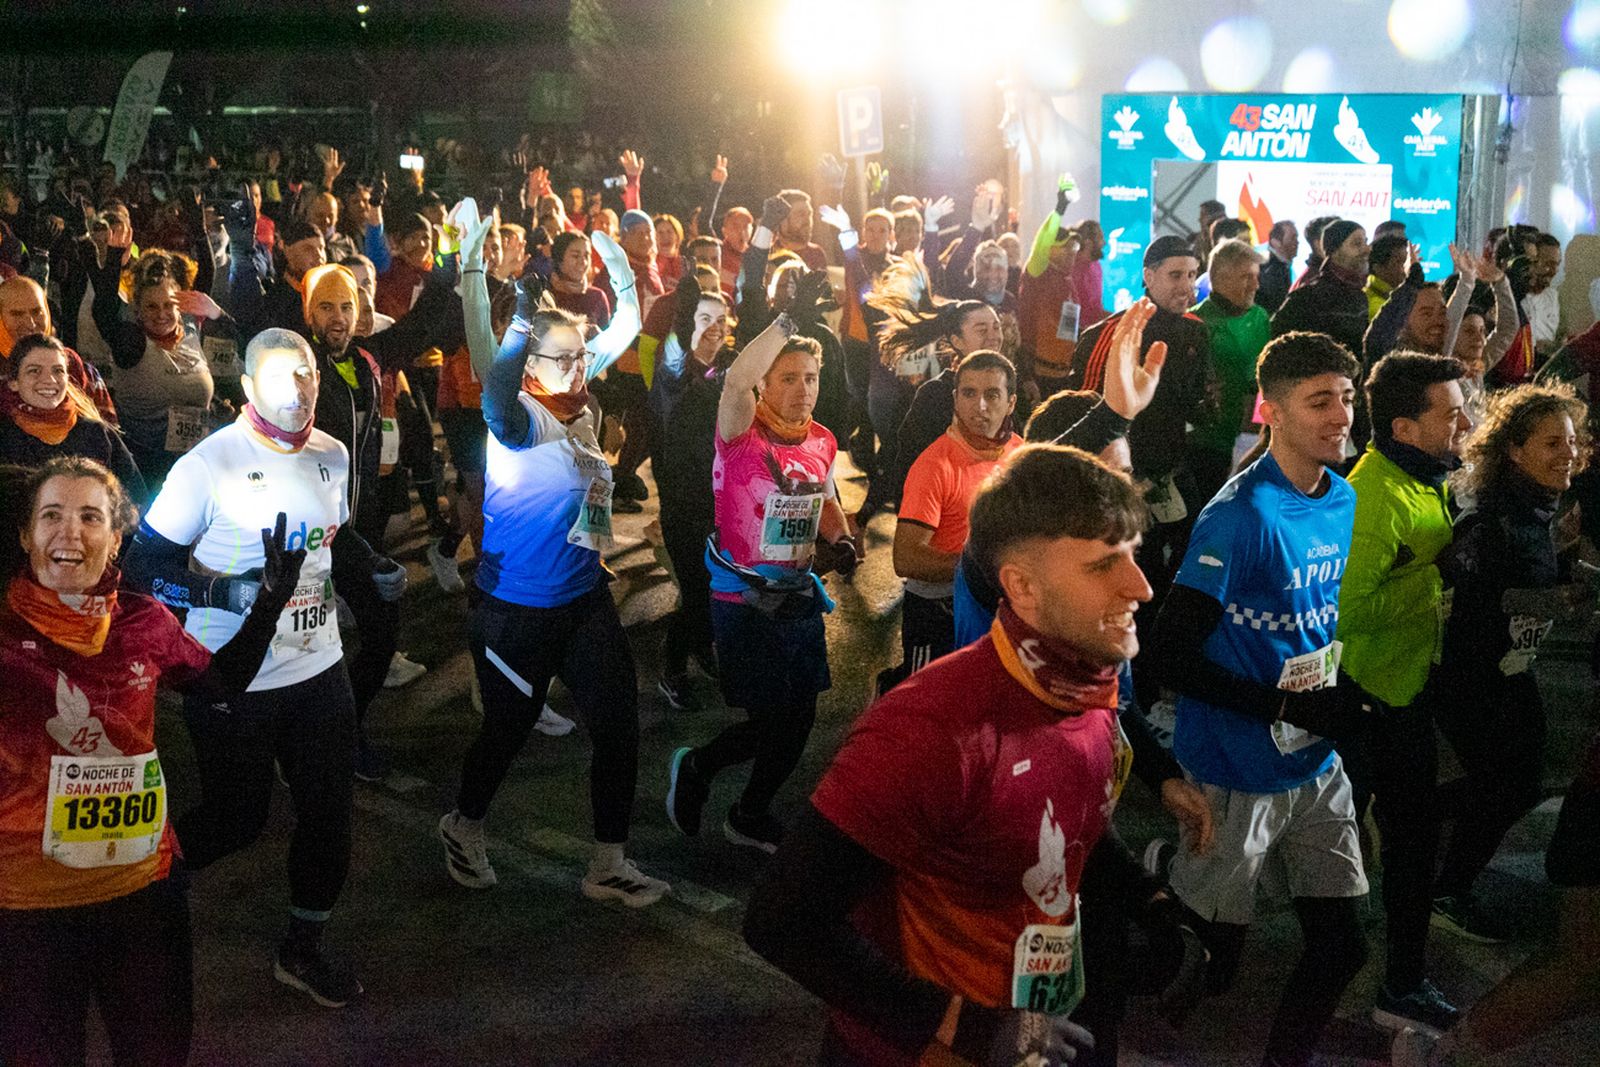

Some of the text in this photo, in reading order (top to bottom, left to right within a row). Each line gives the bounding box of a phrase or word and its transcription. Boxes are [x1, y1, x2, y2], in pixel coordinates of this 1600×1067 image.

[847, 97, 873, 149] P
[1229, 103, 1317, 132] 43 SAN
[1220, 125, 1311, 158] ANTÓN
[1305, 189, 1347, 206] SAN
[291, 603, 327, 632] 1136
[70, 727, 101, 753] 43
[82, 769, 119, 780] NOCHE
[121, 767, 136, 779] DE
[65, 783, 92, 796] SAN
[64, 791, 158, 831] 13360
[1026, 959, 1052, 974] SAN
